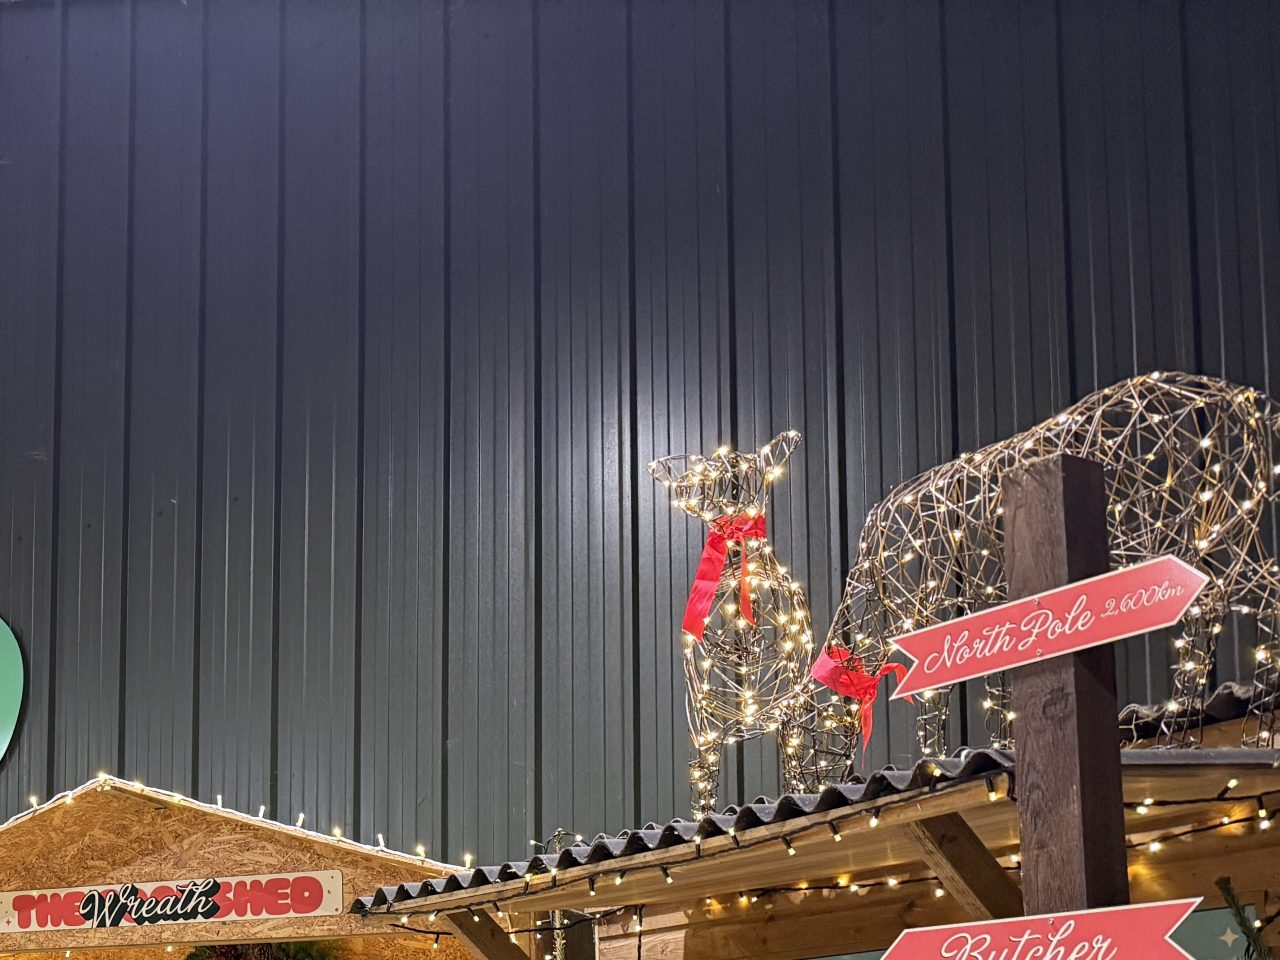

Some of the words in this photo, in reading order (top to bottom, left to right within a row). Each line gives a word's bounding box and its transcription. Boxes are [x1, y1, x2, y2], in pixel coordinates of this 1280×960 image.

[924, 622, 1016, 674] North
[1019, 595, 1095, 651] Pole
[12, 894, 83, 929] THE
[79, 877, 216, 929] Wreath
